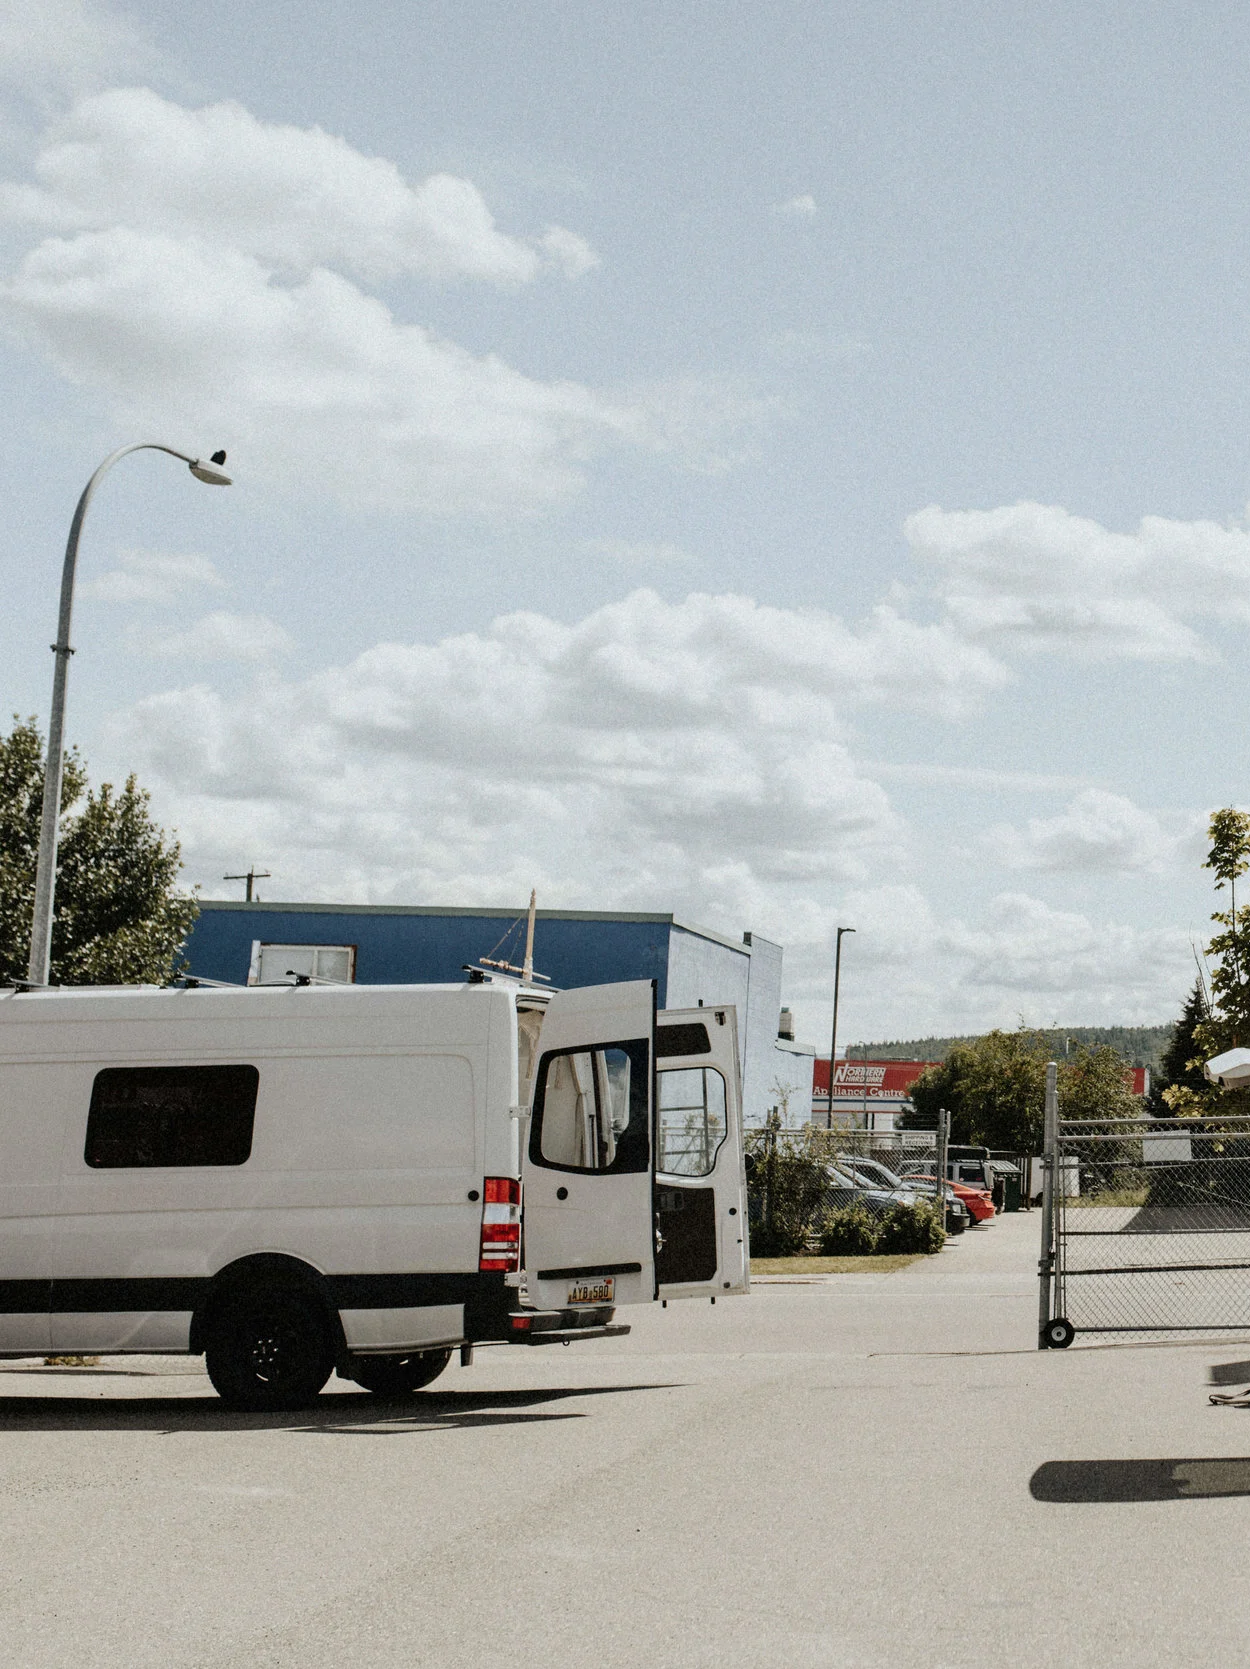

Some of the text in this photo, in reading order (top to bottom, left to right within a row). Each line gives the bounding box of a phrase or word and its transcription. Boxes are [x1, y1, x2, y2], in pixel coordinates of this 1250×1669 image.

[813, 1086, 905, 1097] Apliance Centre
[593, 1284, 609, 1299] 580
